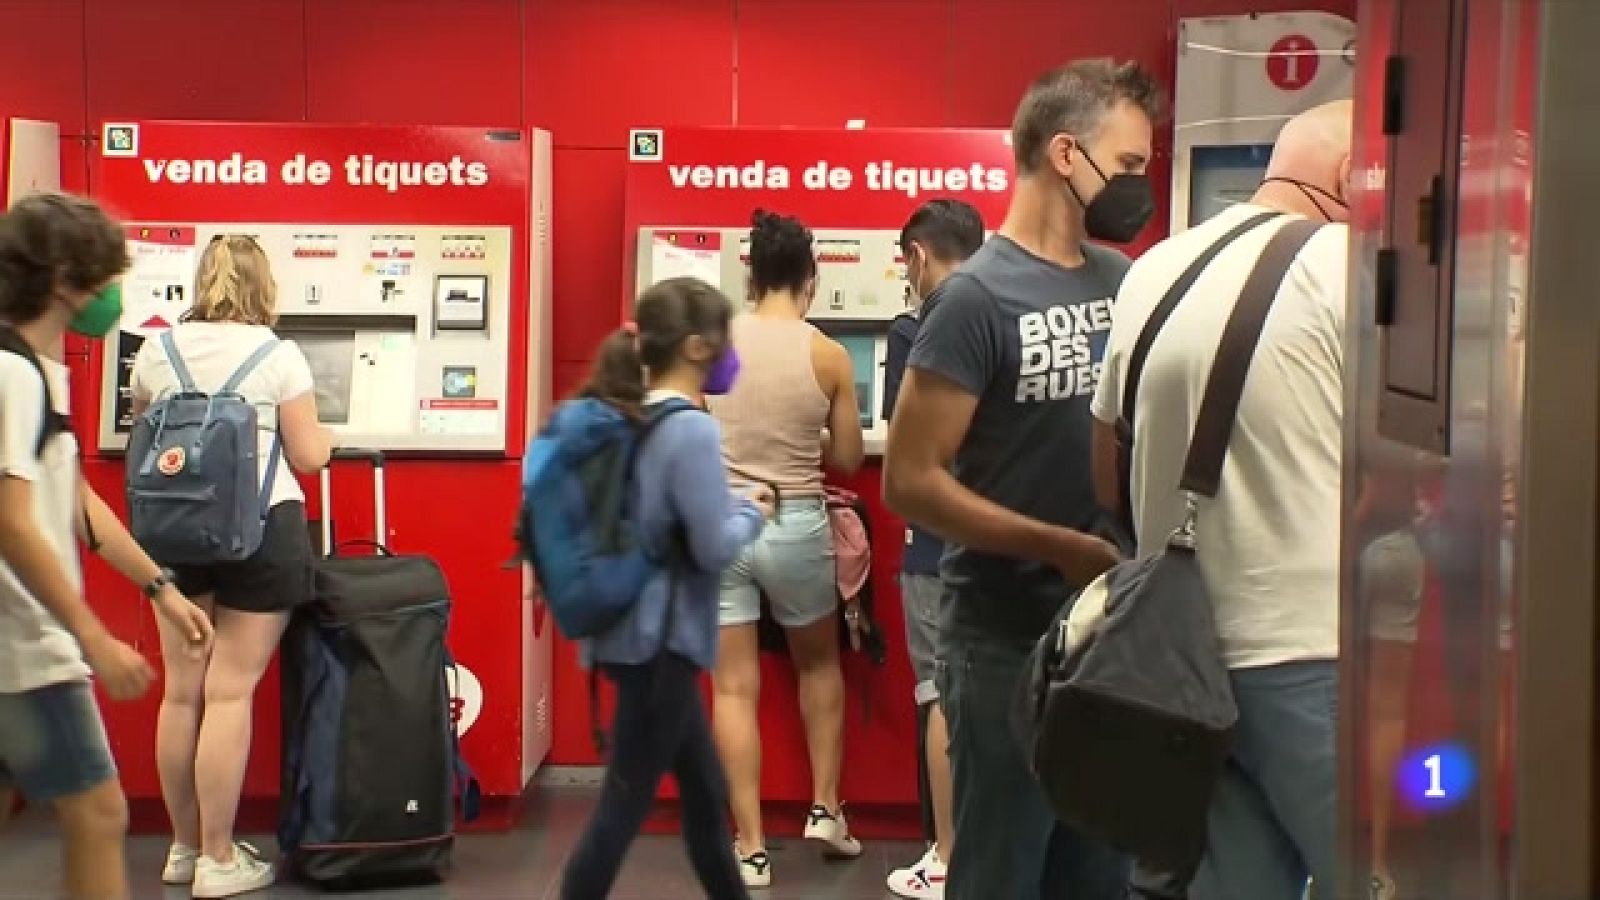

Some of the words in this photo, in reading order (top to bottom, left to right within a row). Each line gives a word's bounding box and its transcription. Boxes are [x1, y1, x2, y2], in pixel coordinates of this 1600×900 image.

[143, 152, 267, 184] venda
[281, 153, 331, 185] de
[345, 154, 489, 193] tiquets
[669, 159, 790, 189] venda
[803, 160, 852, 190] de
[865, 160, 1008, 198] tiquets
[1019, 298, 1114, 344] BOXE
[1020, 334, 1090, 375] DES
